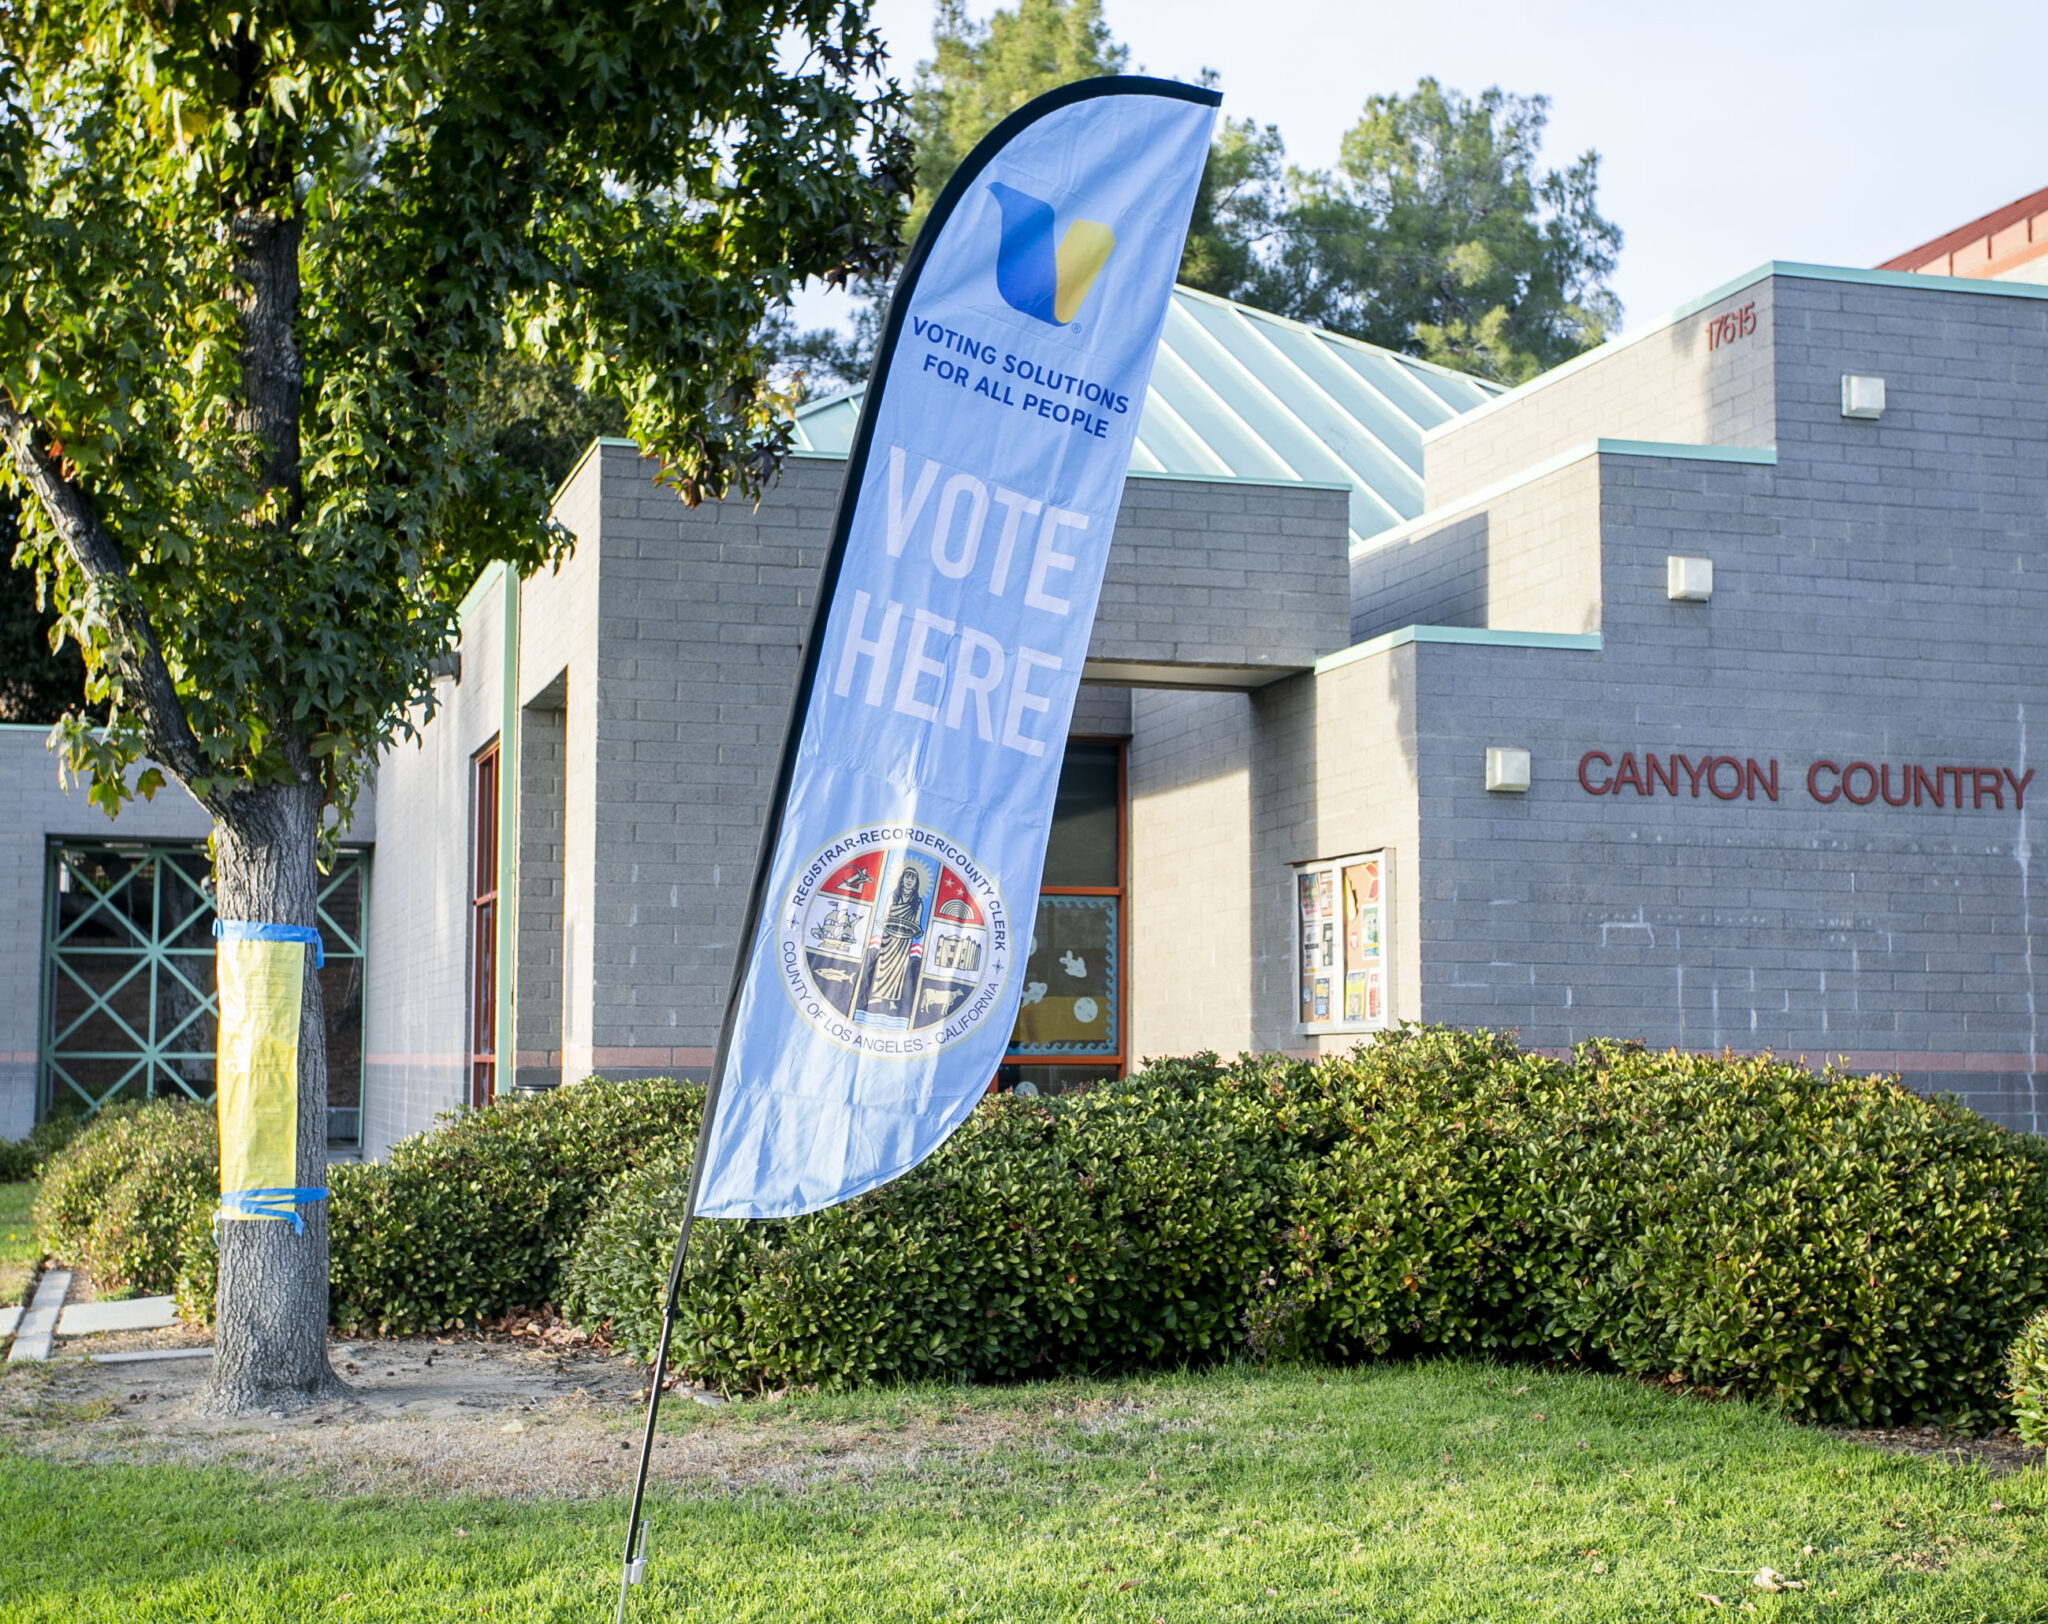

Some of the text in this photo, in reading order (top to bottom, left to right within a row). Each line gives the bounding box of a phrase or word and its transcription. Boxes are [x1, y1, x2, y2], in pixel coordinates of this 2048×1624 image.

[913, 316, 1129, 414] VOTING SOLUTIONS
[1705, 301, 1756, 351] 17615
[923, 353, 1109, 439] FOR ALL PEOPLE
[886, 445, 1089, 616] VOTE
[834, 589, 1063, 757] HERE
[1578, 751, 2035, 810] CANYON COUNTRY
[988, 899, 1006, 951] CLERK
[783, 941, 812, 1001] COUNTY
[806, 1002, 826, 1020] OF
[823, 1017, 851, 1042] LOS
[852, 1035, 924, 1053] ANGELES
[935, 981, 999, 1044] CALIFORNIA
